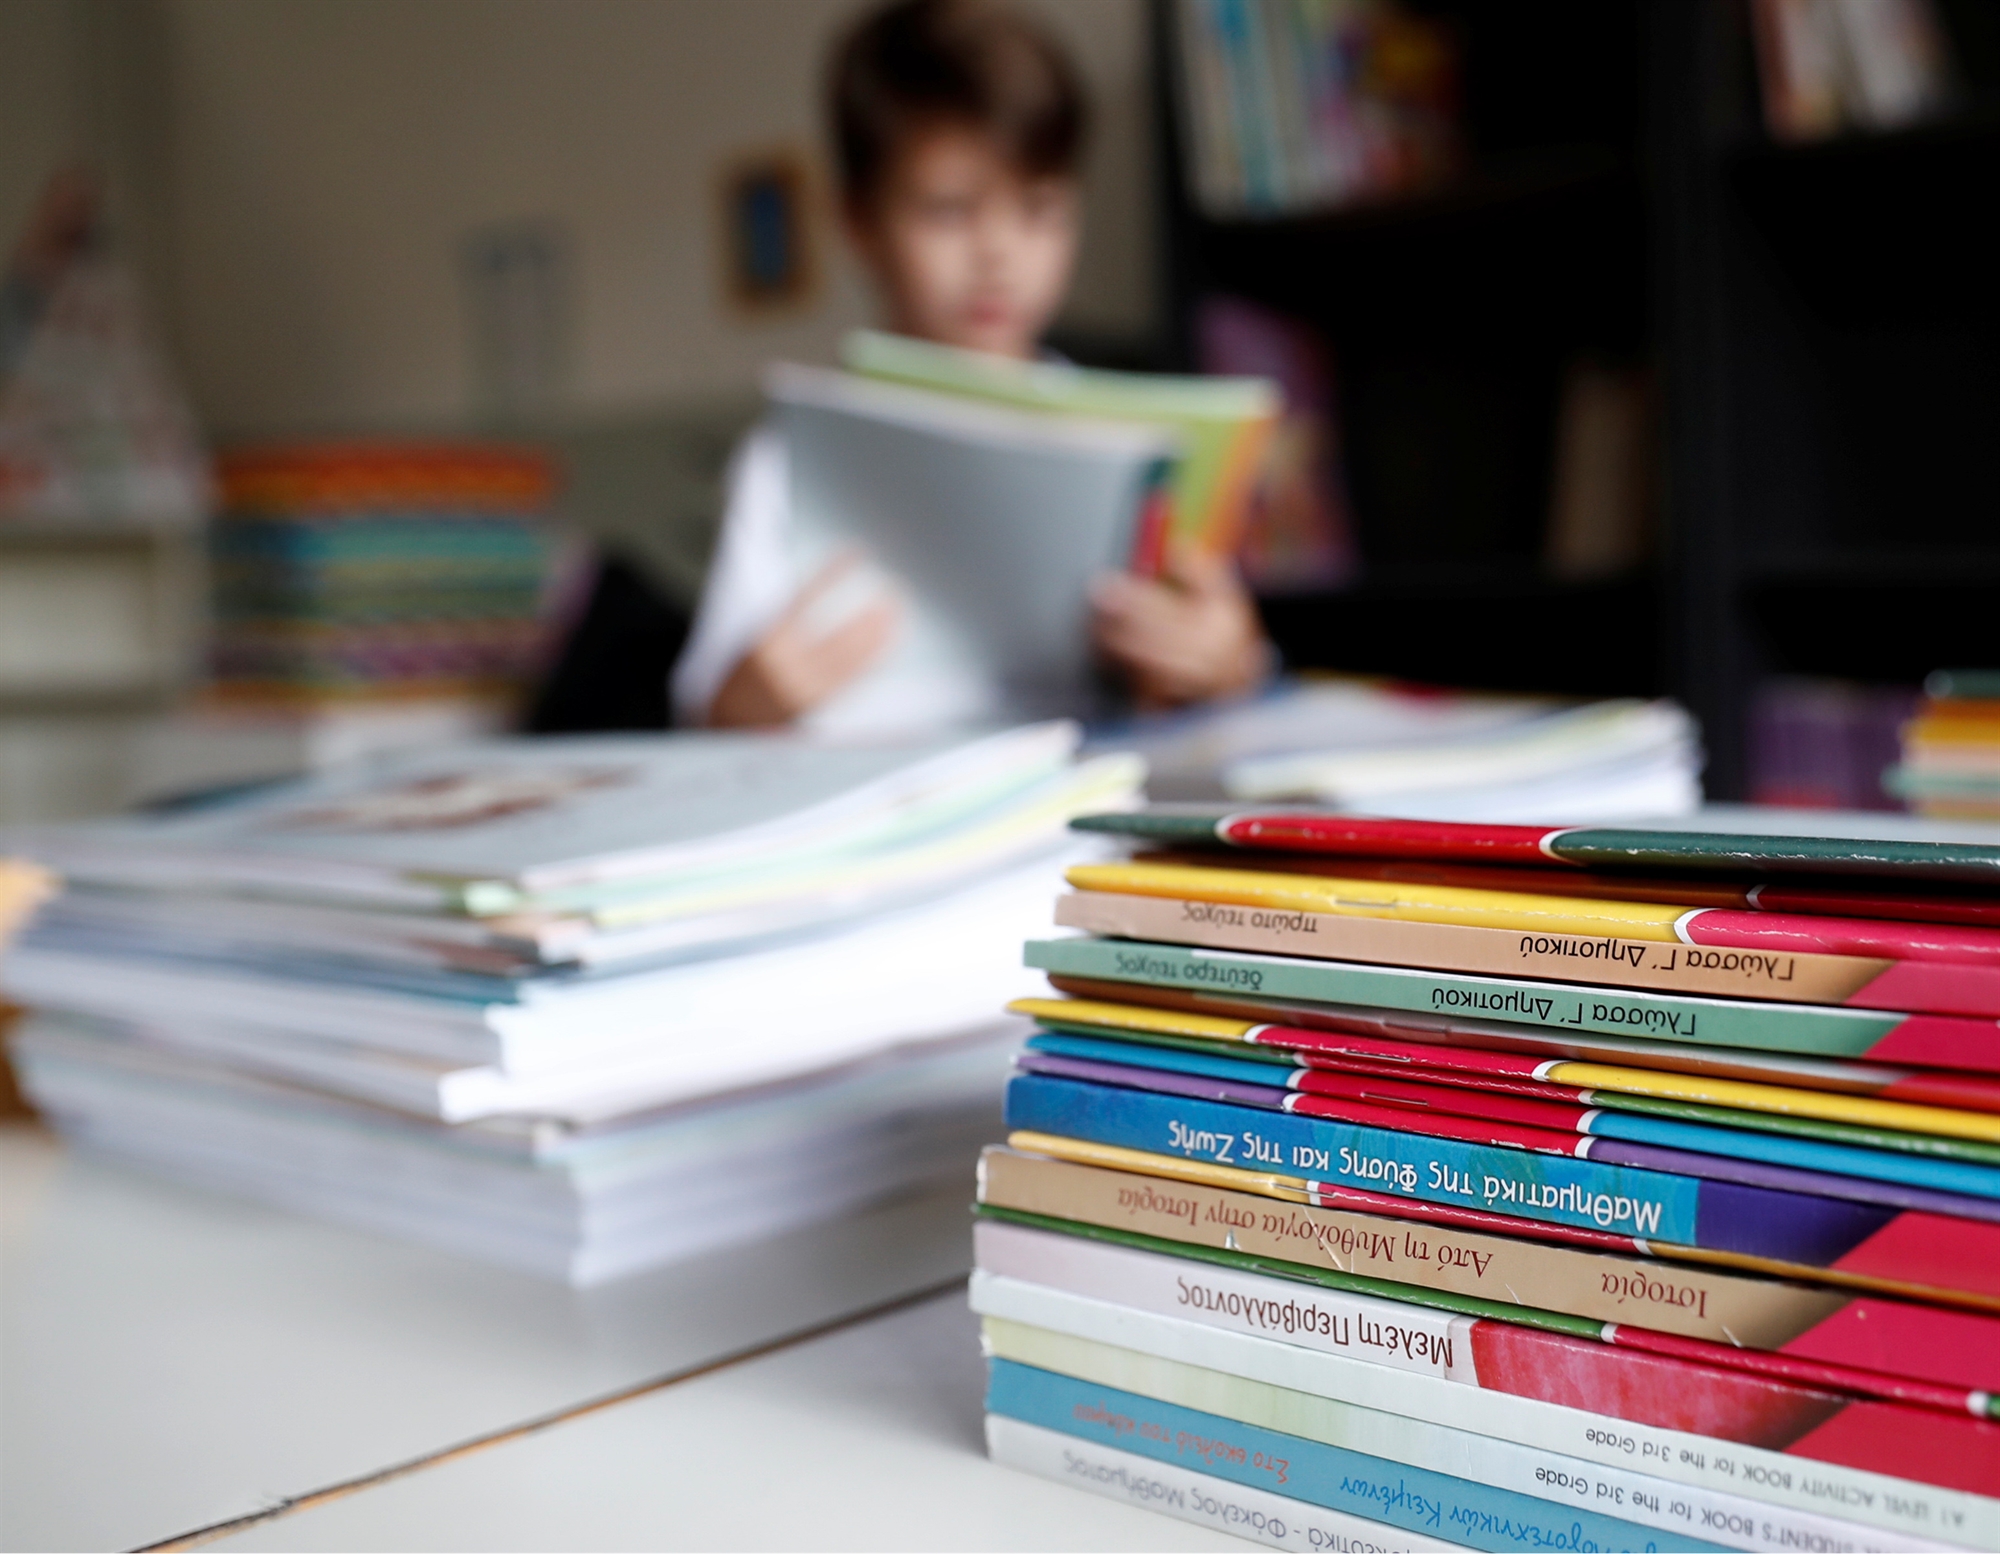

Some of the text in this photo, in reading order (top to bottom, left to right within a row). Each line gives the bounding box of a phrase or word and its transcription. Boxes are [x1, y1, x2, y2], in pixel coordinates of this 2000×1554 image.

[1180, 902, 1318, 934] πρώτο τεύχος
[1520, 936, 1646, 968] Δημοτικού
[1686, 950, 1794, 981] Γλώσσα
[1116, 954, 1263, 991] δεύτερο τεύχος
[1431, 988, 1553, 1021] Δημοτικού
[1593, 1004, 1696, 1036] Γλώσσα
[1168, 1120, 1662, 1233] Μαθηματικά της Φύσης και της Ζωής
[1117, 1186, 1494, 1278] Από τη Μυθολογία στην Ιστορία
[1601, 1270, 1709, 1319] Ιστορία
[1178, 1276, 1453, 1368] Μελέτη Περιβάλλοντος
[1586, 1429, 1635, 1452] Grade
[1643, 1442, 1670, 1462] 3rd
[1253, 1452, 1289, 1484] Στο
[1680, 1450, 1705, 1468] the
[1714, 1458, 1735, 1477] for
[1535, 1467, 1588, 1495] Grade
[1742, 1464, 1792, 1489] BOOK
[1800, 1478, 1874, 1506] ACTIVITY
[1340, 1477, 1440, 1528] Κειμένων
[1597, 1482, 1624, 1504] 3rd
[1632, 1492, 1659, 1512] the
[1191, 1488, 1286, 1538] Φάκελος
[1669, 1501, 1692, 1520] for
[1701, 1508, 1753, 1536] BOOK
